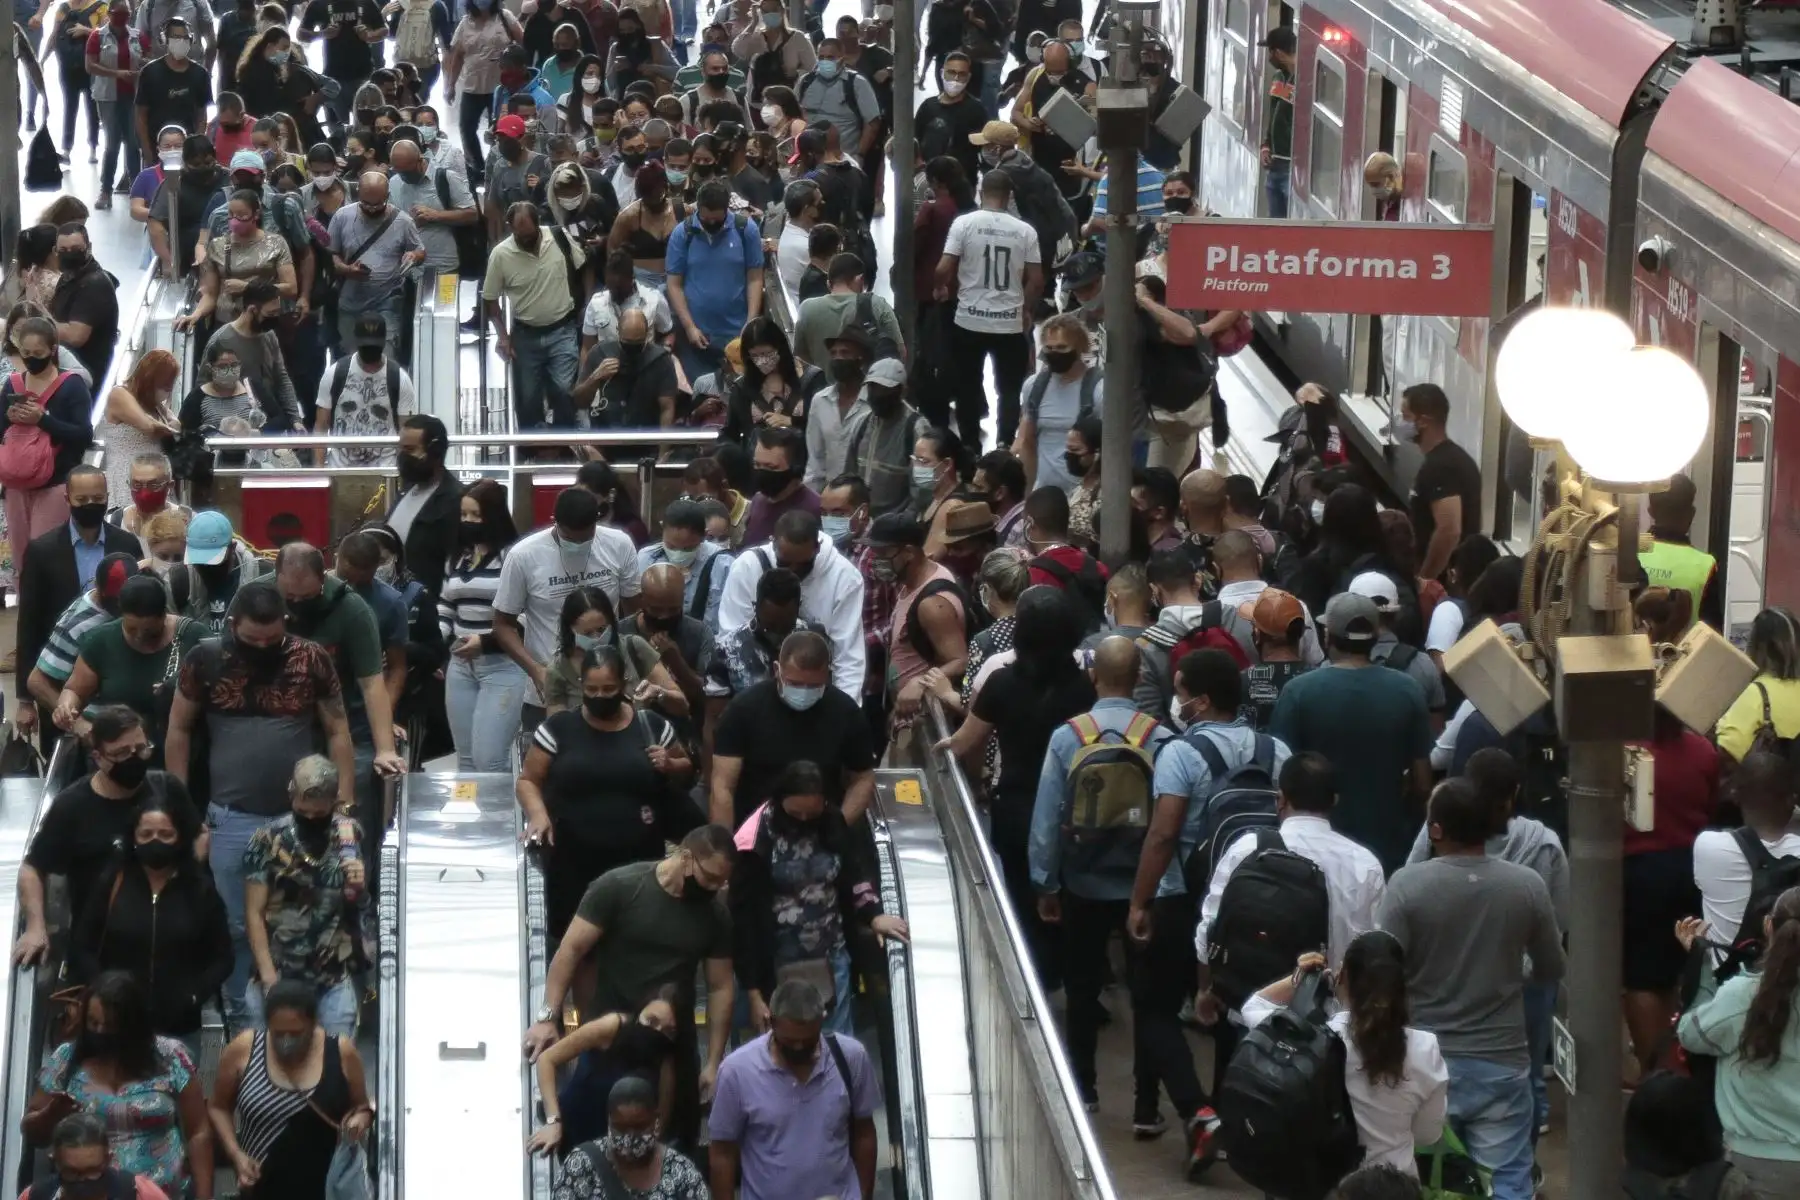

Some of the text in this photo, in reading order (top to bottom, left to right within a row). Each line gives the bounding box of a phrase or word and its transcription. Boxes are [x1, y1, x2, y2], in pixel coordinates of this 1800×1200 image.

[984, 244, 1011, 291] 10
[1207, 246, 1450, 280] Plataforma 3
[1203, 277, 1269, 293] Platform
[968, 306, 1017, 319] Unimed
[459, 470, 481, 480] Lixo
[549, 569, 612, 586] Hang Loose
